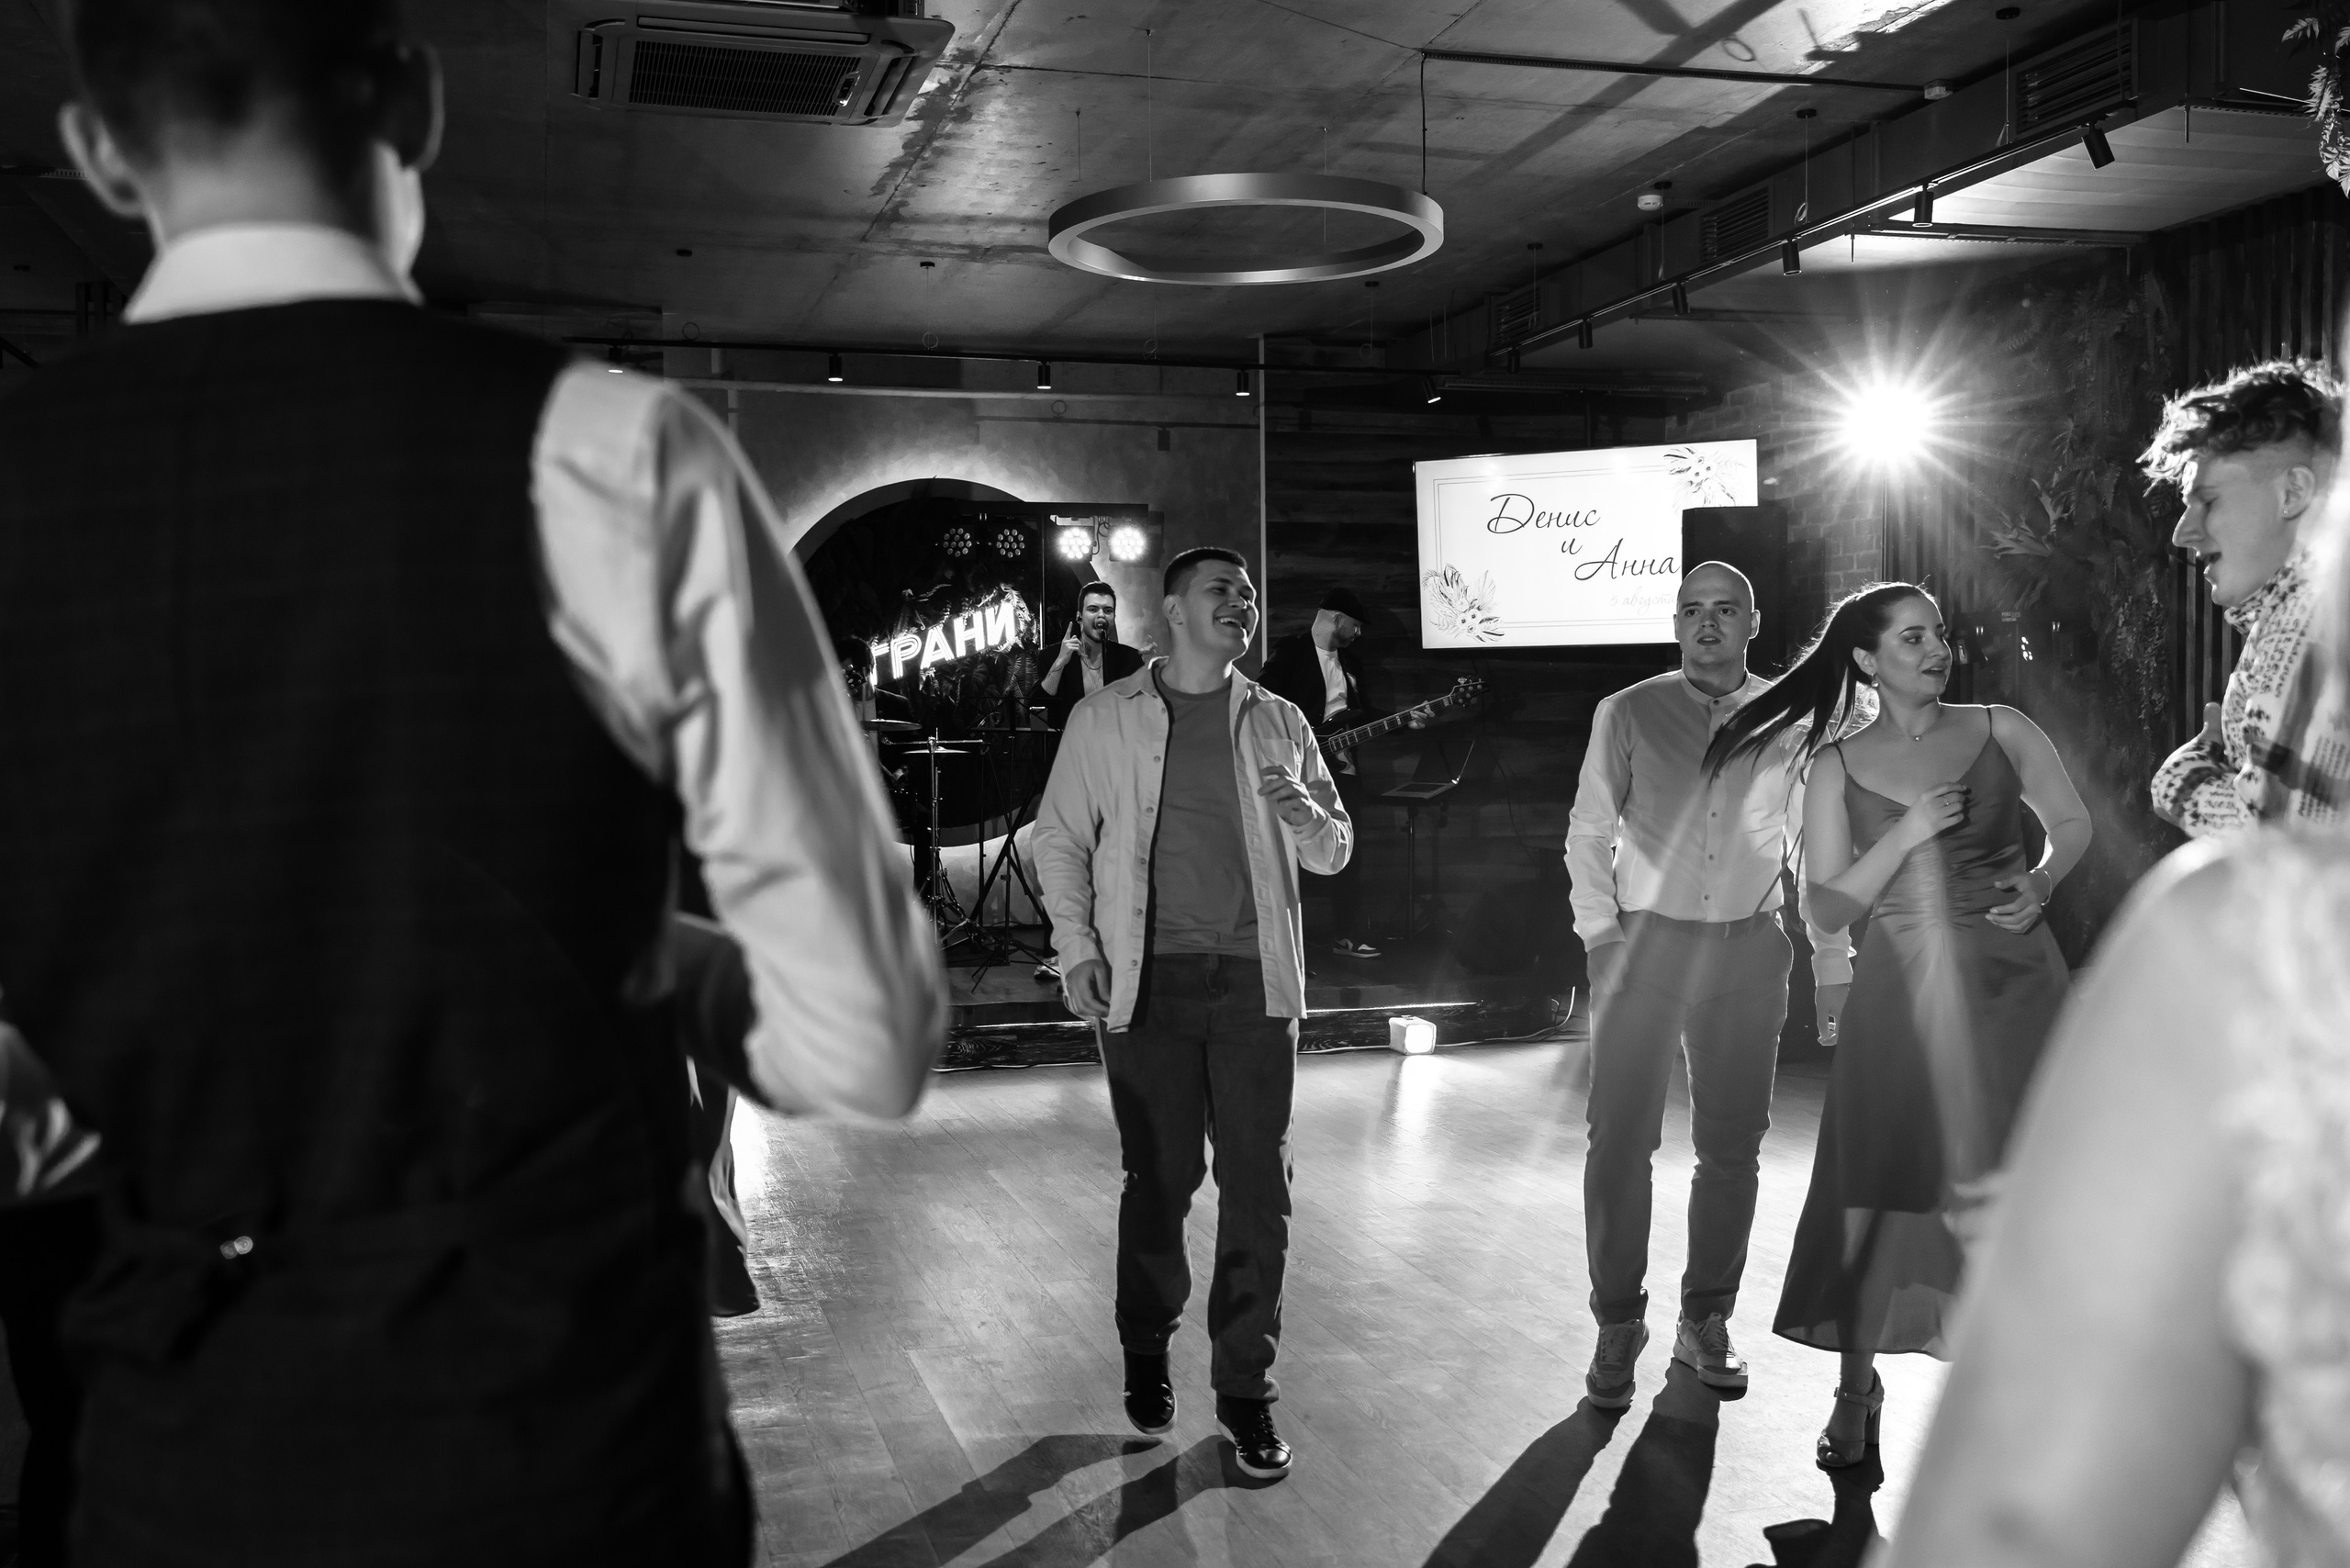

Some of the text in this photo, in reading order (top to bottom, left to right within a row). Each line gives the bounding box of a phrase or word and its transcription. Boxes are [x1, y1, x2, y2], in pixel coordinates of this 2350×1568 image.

[1487, 493, 1601, 534] Денис
[1561, 538, 1583, 555] и
[1574, 538, 1681, 581] Анна
